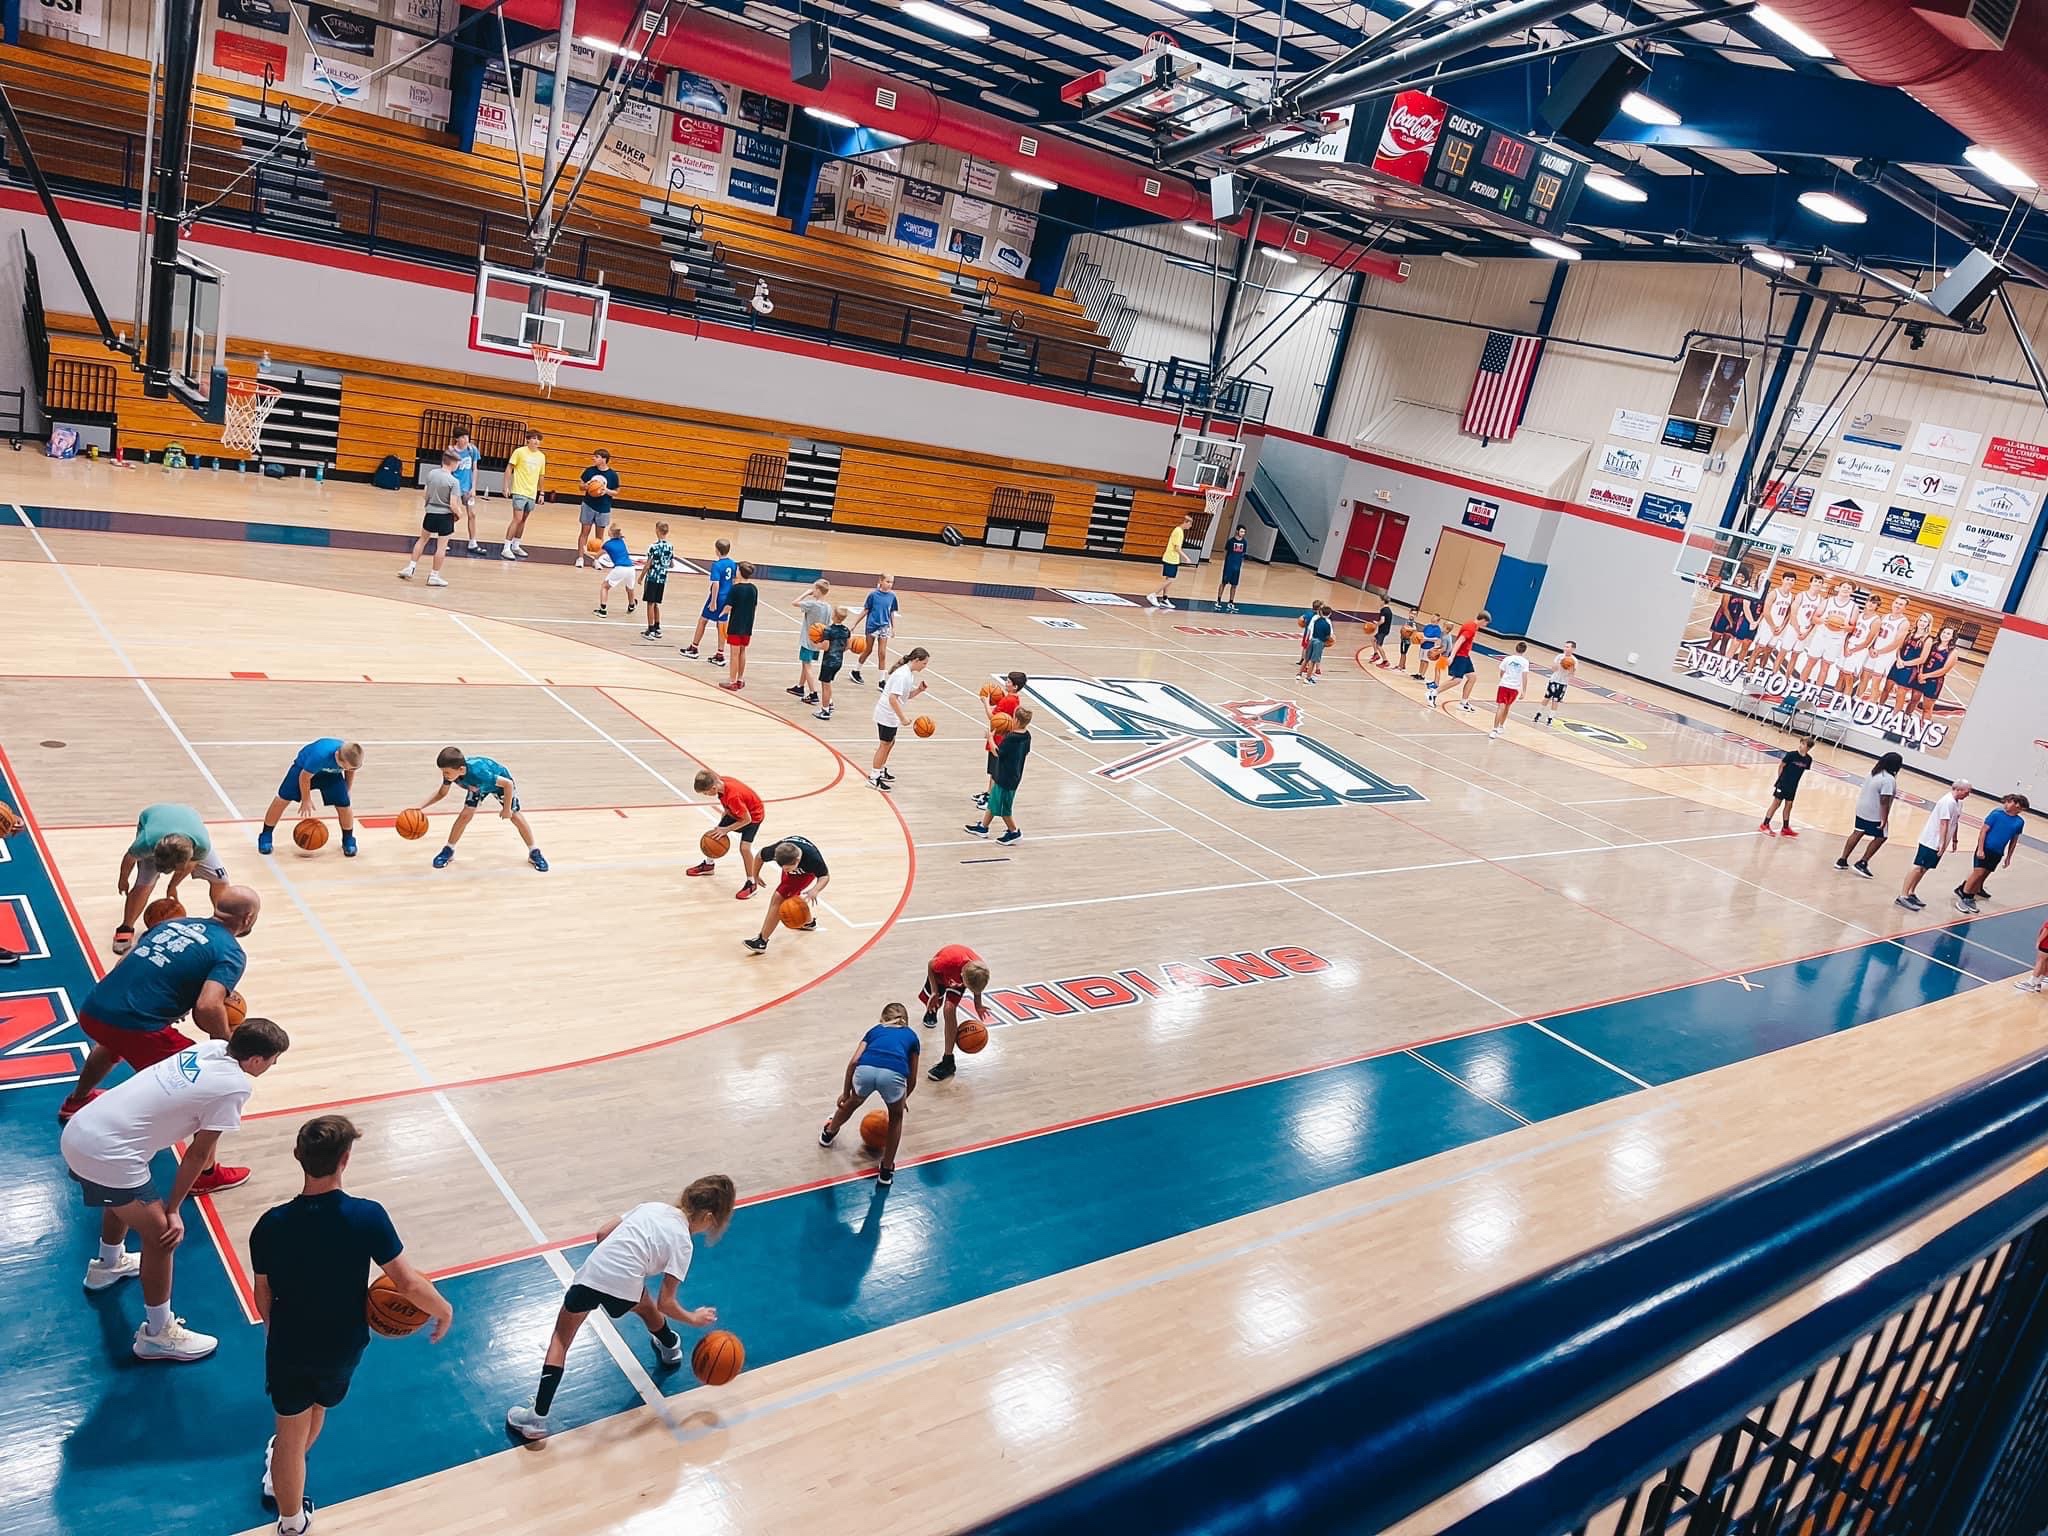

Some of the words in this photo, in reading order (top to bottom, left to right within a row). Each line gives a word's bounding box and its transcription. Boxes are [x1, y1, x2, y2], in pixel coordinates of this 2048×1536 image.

[1448, 115, 1483, 139] GUEST
[615, 140, 646, 163] BAKER
[1314, 139, 1338, 156] You
[627, 155, 650, 171] EXCAVATION
[1448, 139, 1473, 177] 43
[1541, 153, 1570, 173] HOME
[1470, 181, 1499, 199] PERIOD
[1992, 444, 2015, 454] TOTAL
[2005, 441, 2040, 452] ALABAMA
[1826, 505, 1865, 523] CMS
[1978, 527, 2014, 541] INDIANS!
[725, 567, 732, 580] 3
[1882, 562, 1915, 579] TVEC
[1685, 646, 1745, 683] NEW
[1751, 667, 1825, 704] HOPE
[1828, 694, 1948, 749] INDIANS
